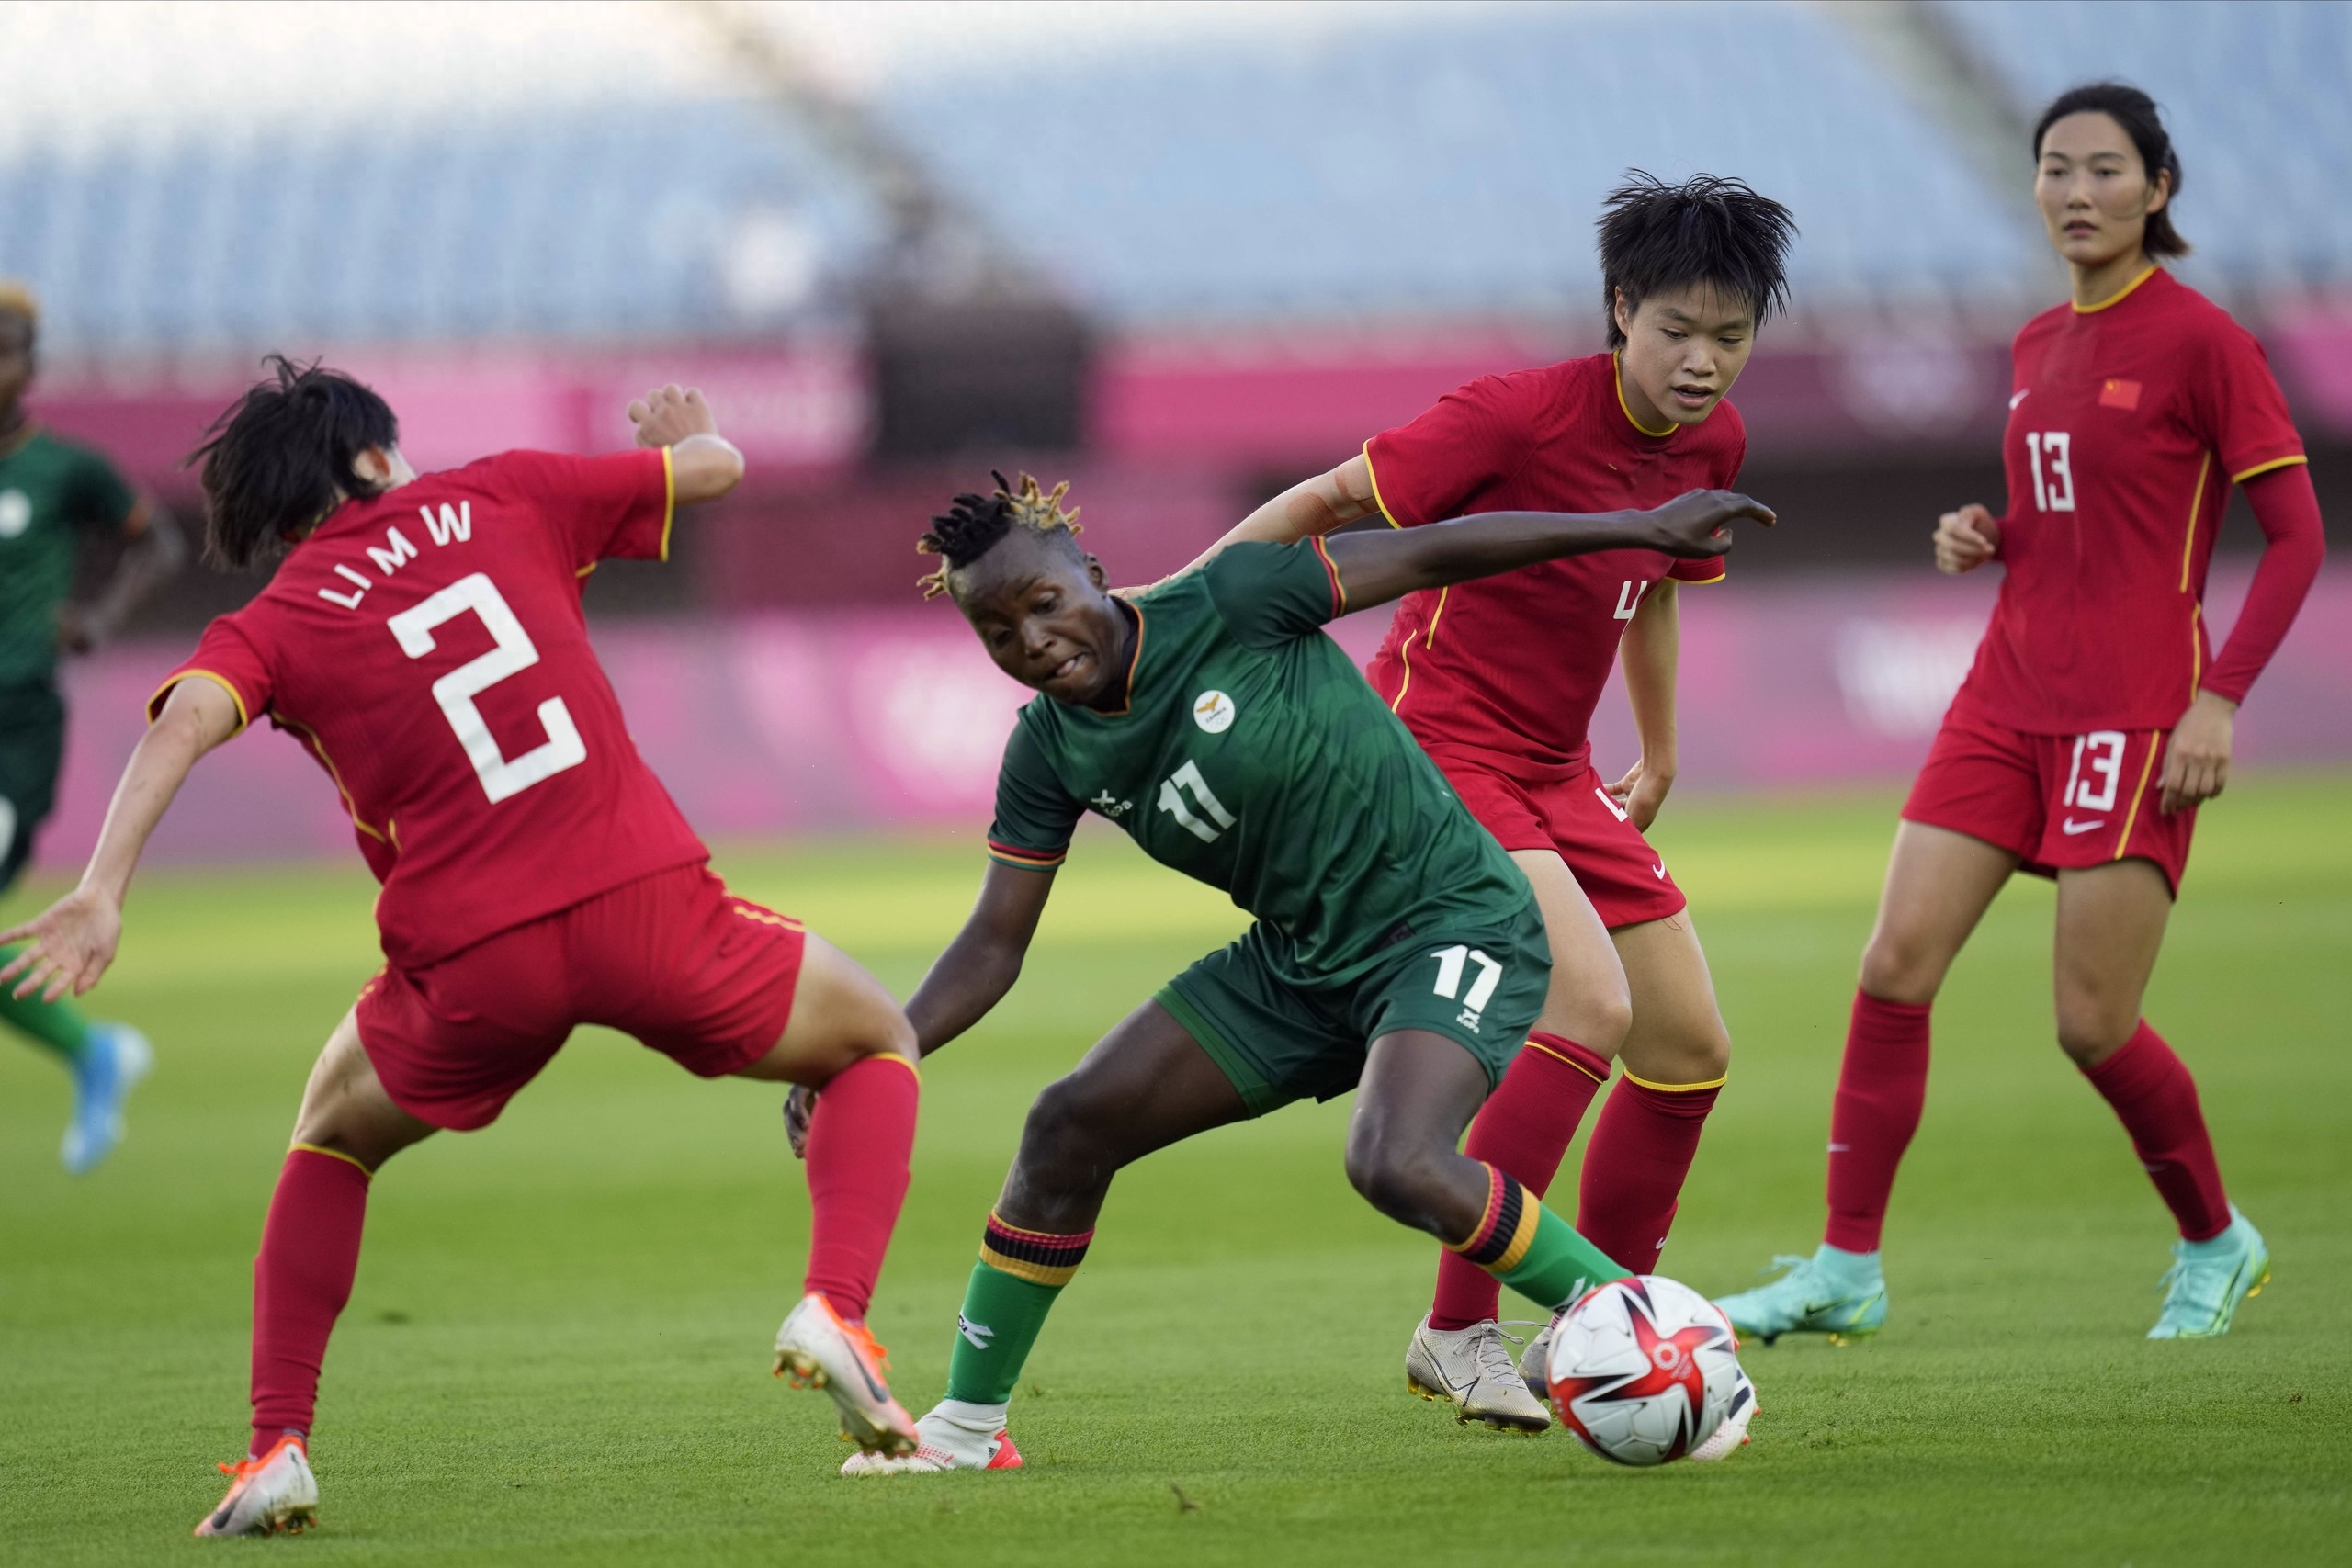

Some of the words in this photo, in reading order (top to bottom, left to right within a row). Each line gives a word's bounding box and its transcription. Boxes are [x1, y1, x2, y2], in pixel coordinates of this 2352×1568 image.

[2026, 431, 2075, 512] 13
[387, 571, 587, 804] 2
[1156, 759, 1238, 844] 17
[2063, 730, 2127, 812] 13
[1430, 944, 1503, 1014] 17
